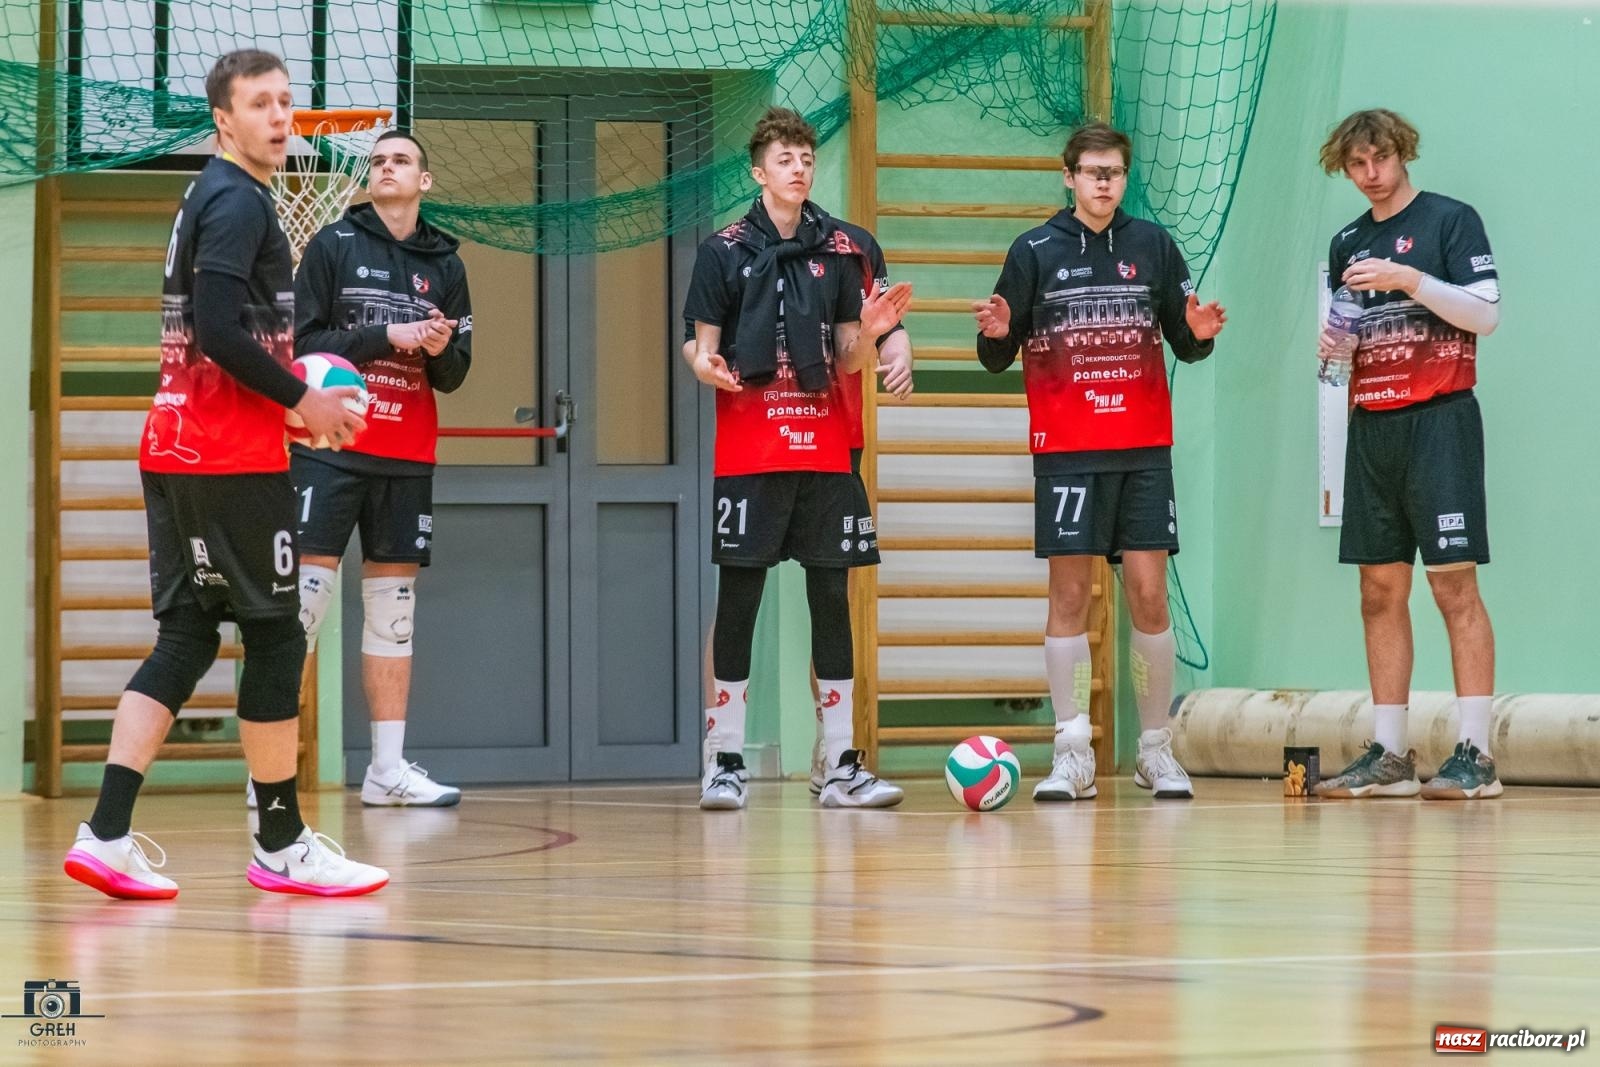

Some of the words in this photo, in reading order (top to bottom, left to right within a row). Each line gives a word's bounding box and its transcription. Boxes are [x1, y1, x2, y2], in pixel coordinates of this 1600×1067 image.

[1033, 432, 1047, 448] 77
[297, 486, 313, 523] 1
[717, 497, 748, 535] 21
[1053, 486, 1086, 523] 77
[274, 530, 294, 577] 6
